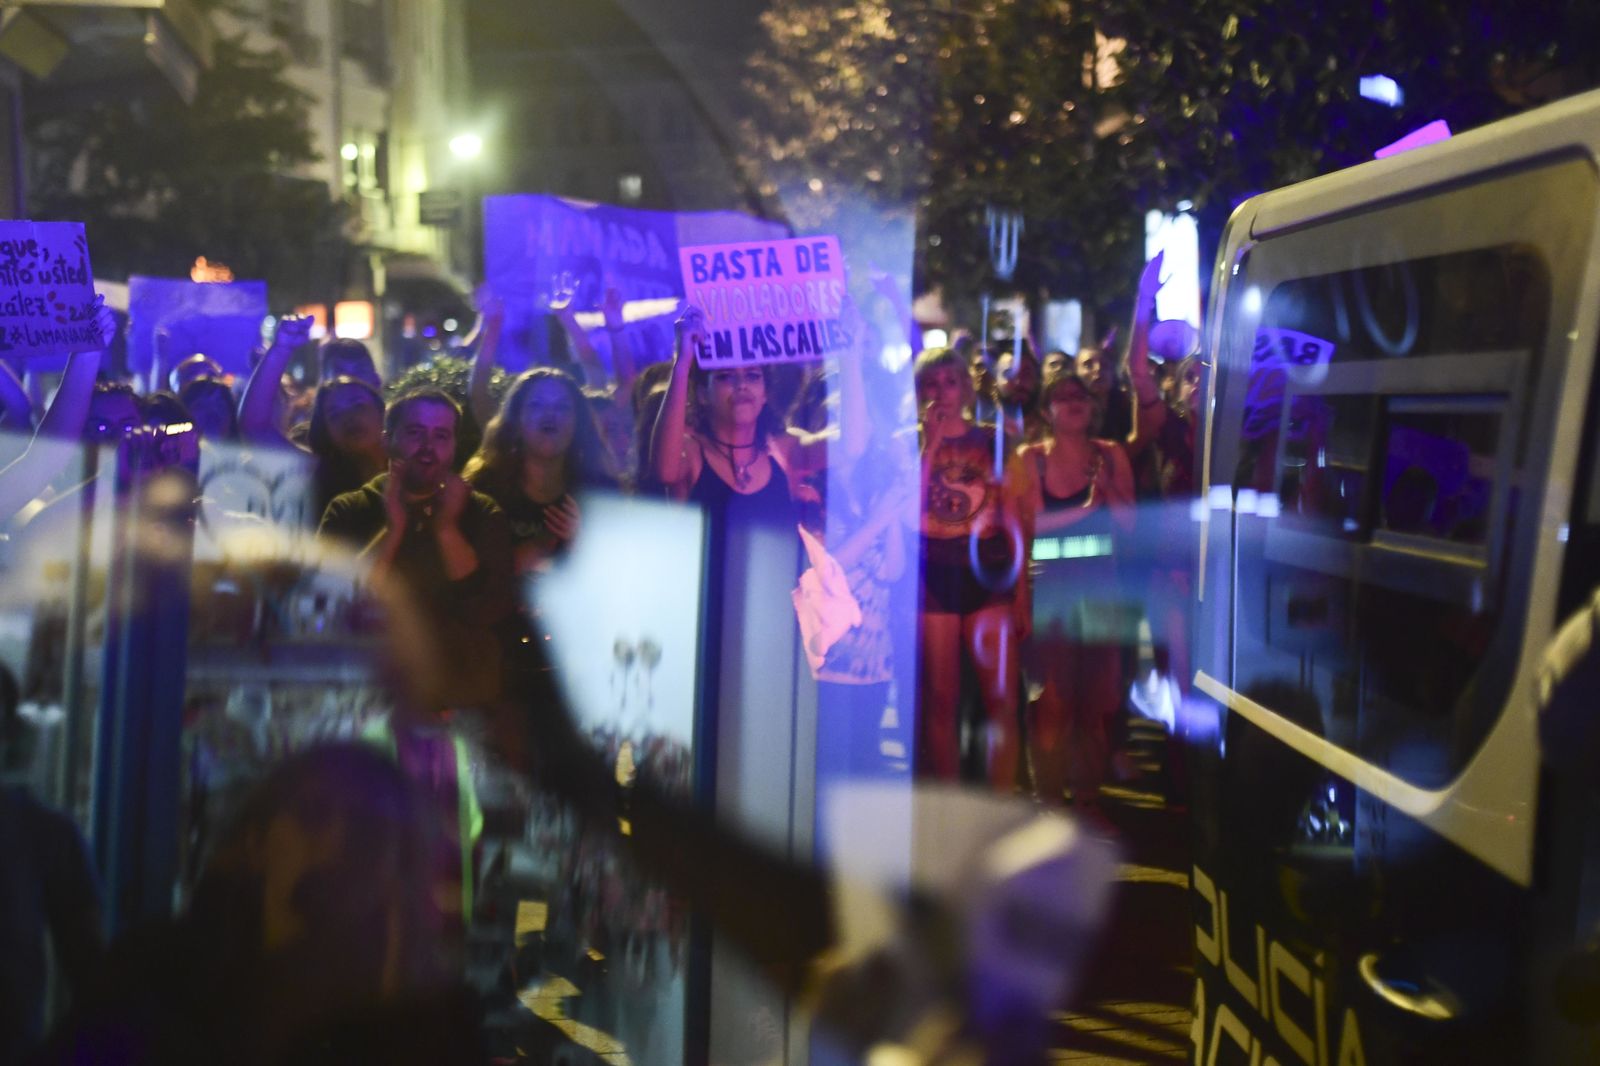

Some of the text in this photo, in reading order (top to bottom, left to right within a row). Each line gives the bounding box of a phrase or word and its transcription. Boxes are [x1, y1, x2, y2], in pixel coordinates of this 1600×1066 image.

[38, 253, 88, 286] usted
[691, 241, 831, 283] BASTA DE
[695, 279, 841, 325] VIOLADORES
[700, 329, 733, 359] EN
[739, 322, 784, 360] LAS
